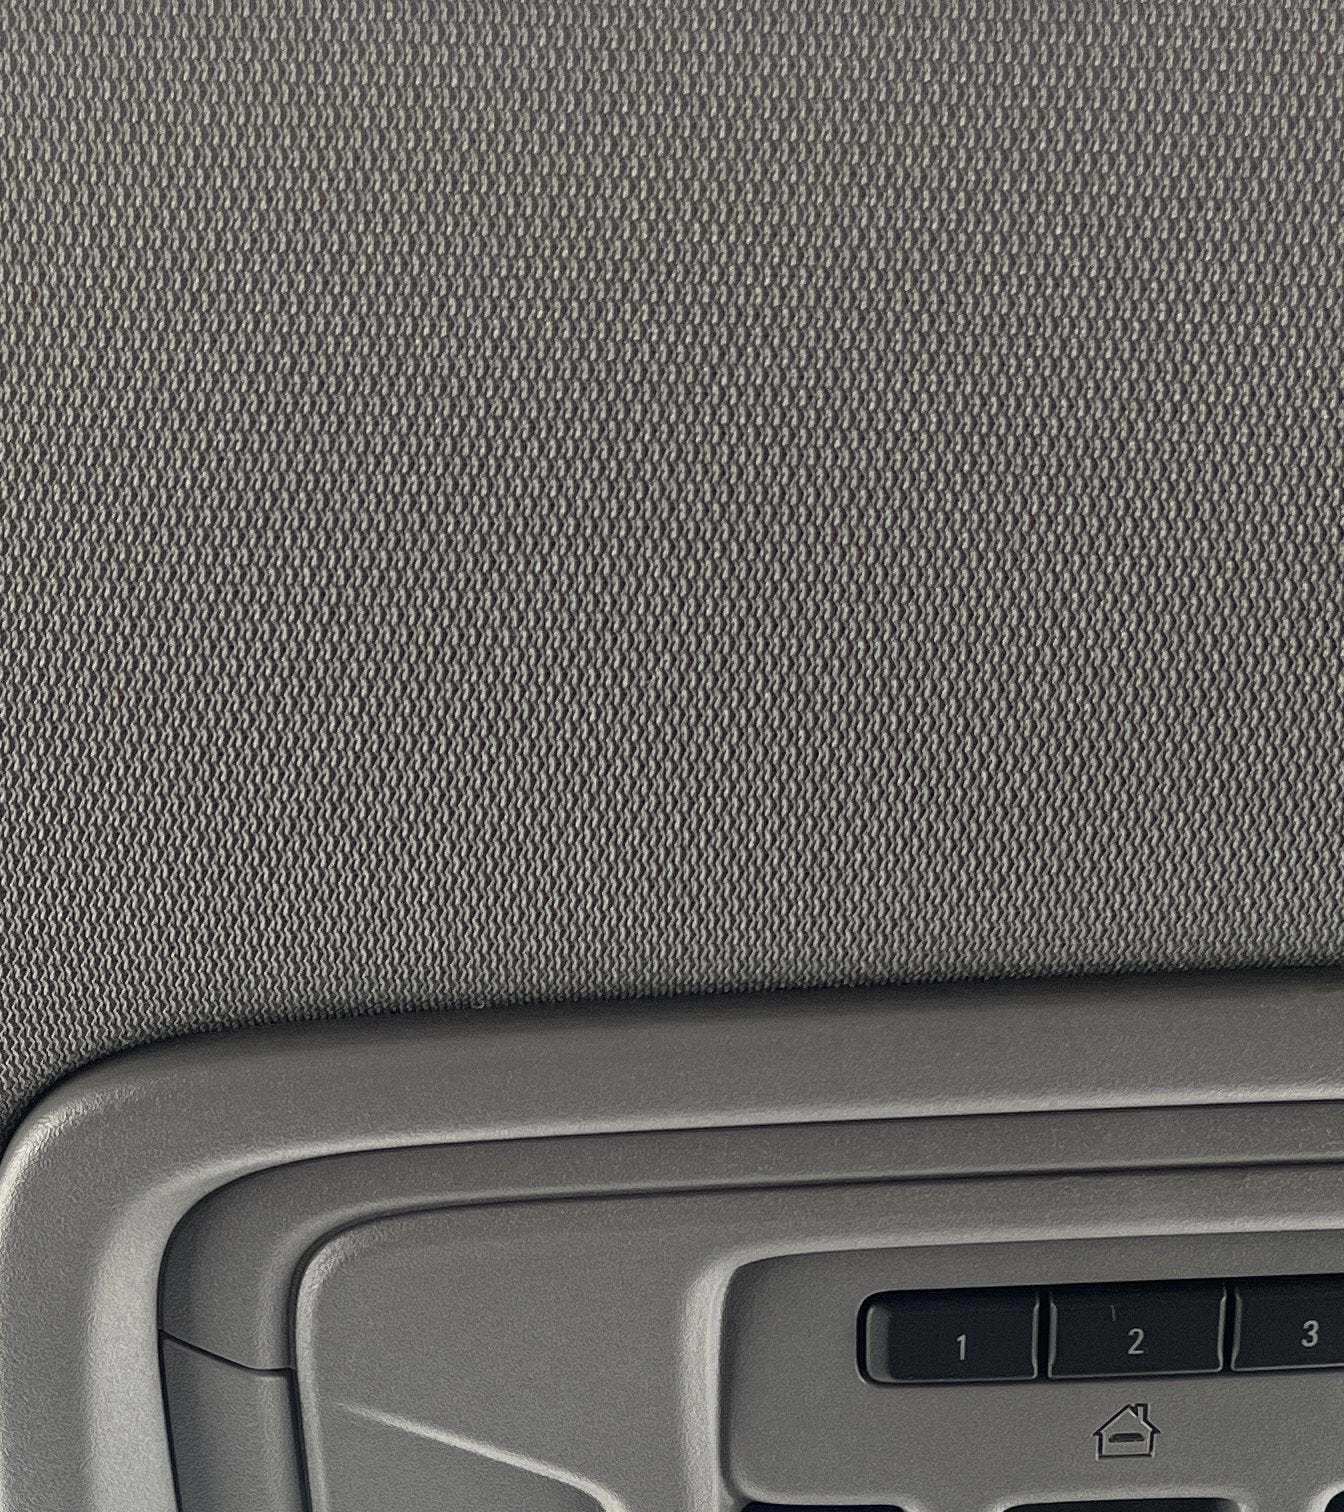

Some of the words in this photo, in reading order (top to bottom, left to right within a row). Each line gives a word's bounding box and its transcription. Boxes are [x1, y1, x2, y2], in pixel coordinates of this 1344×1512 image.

[956, 1334, 967, 1360] 1
[1127, 1329, 1145, 1355] 2
[1301, 1321, 1319, 1347] 3
